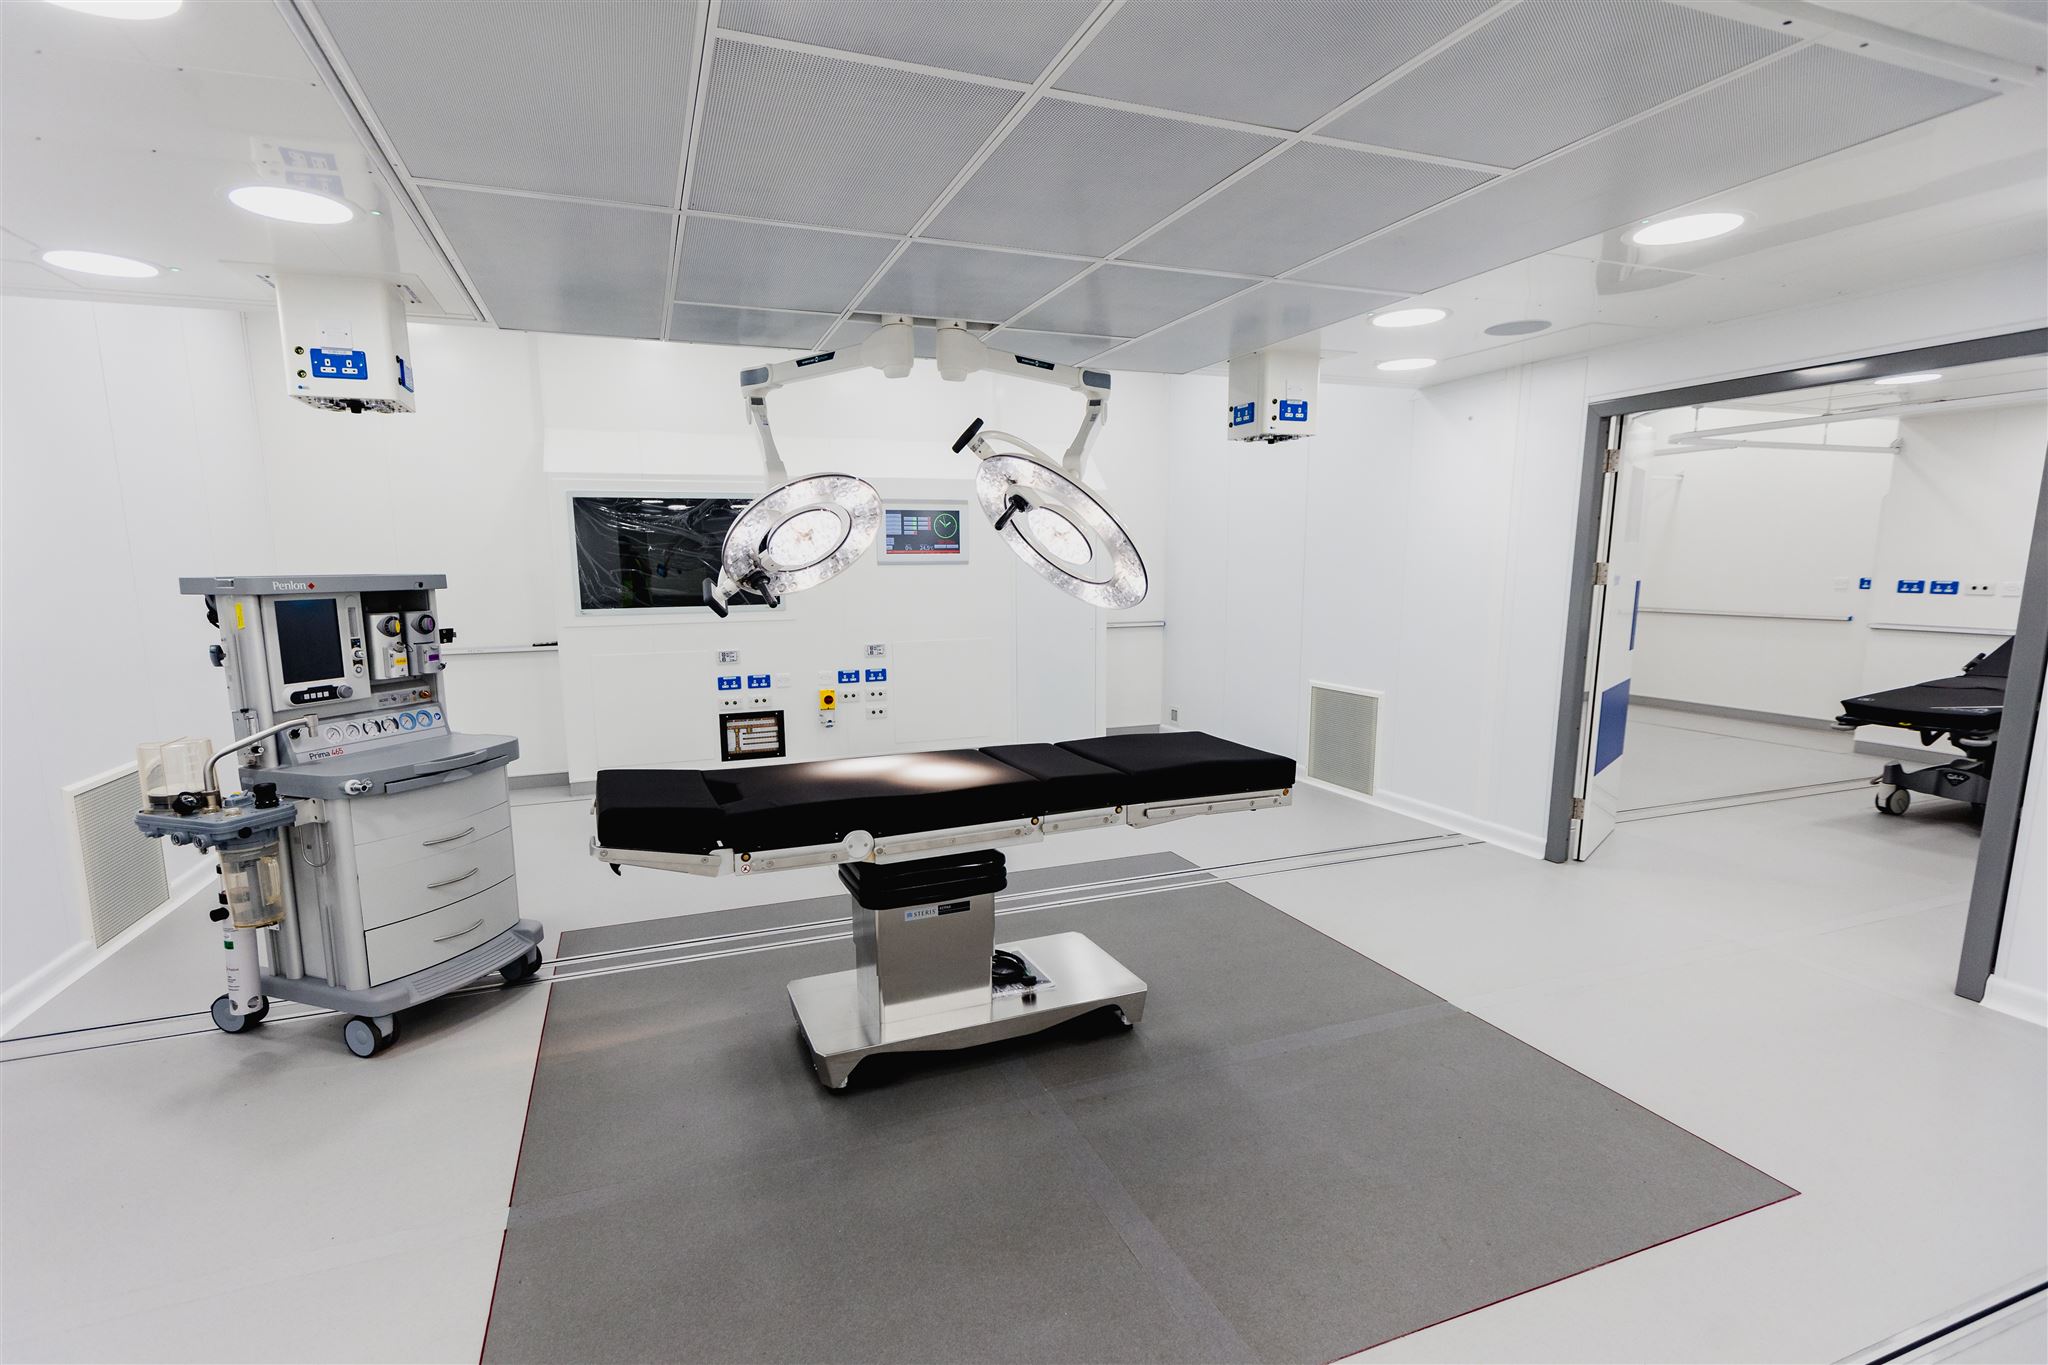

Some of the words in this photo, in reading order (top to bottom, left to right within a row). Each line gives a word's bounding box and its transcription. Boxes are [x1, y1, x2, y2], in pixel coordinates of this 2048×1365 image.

[272, 581, 307, 591] Penlon
[309, 752, 330, 760] Prima
[914, 909, 936, 917] STERIS
